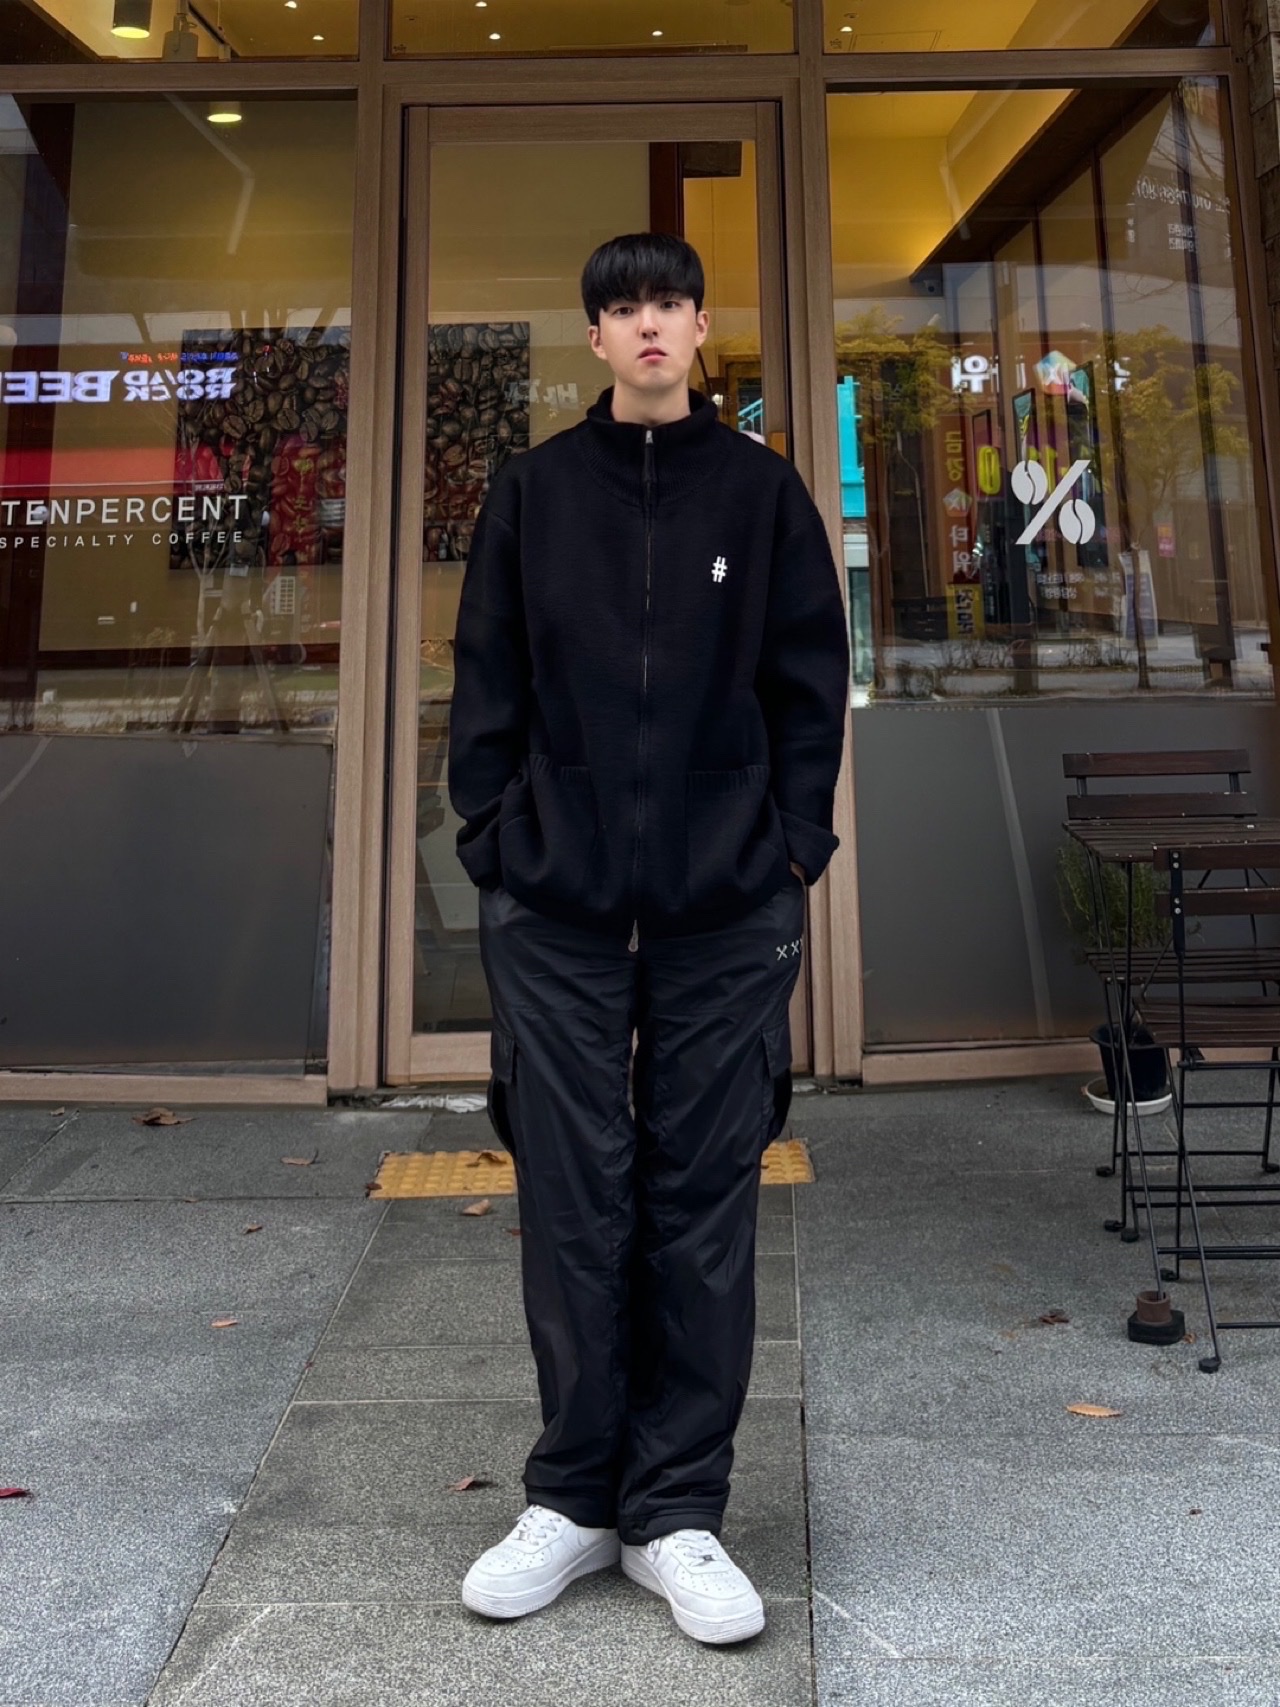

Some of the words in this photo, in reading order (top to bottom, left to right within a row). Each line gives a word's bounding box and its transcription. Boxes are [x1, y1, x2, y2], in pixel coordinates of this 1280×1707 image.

[1, 494, 249, 526] TENPERCENT
[0, 534, 135, 549] SPECIALTY
[152, 531, 243, 545] COFFEE
